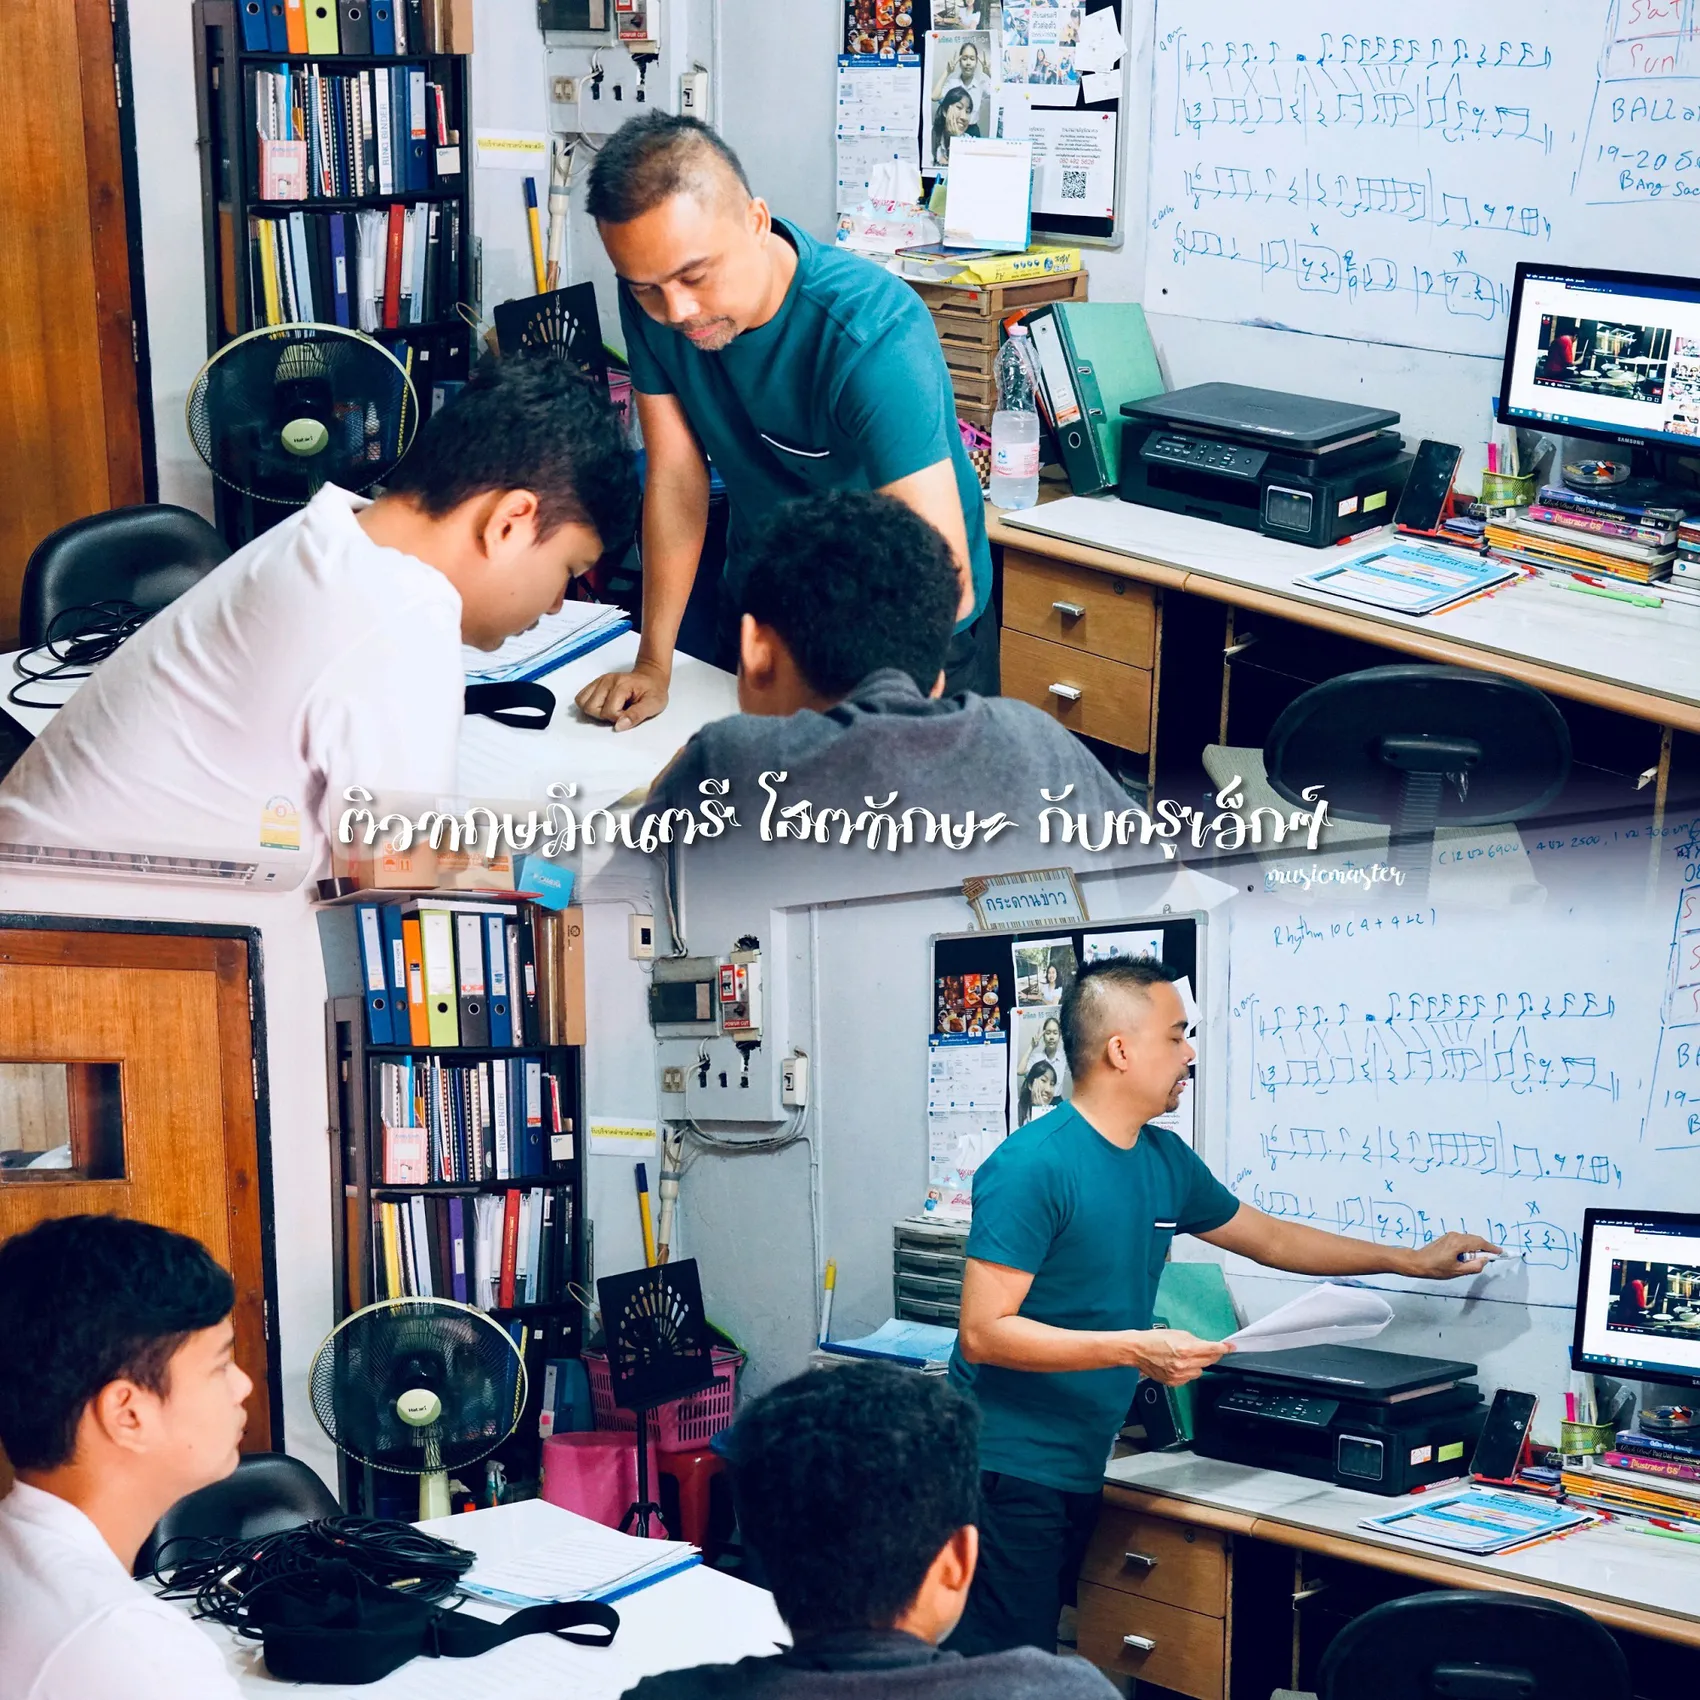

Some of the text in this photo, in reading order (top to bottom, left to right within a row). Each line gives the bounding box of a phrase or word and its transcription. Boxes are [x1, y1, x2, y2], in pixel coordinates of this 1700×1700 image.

[1630, 43, 1675, 74] Sun
[380, 103, 390, 166] RING BINDER
[1616, 435, 1646, 447] SAMSUNG
[1553, 513, 1588, 528] Illustrator
[985, 887, 1068, 911] กระดานข่าว
[1273, 914, 1324, 954] Rhythm
[497, 1092, 507, 1152] RING BINDER
[1629, 1458, 1665, 1473] Illustrator
